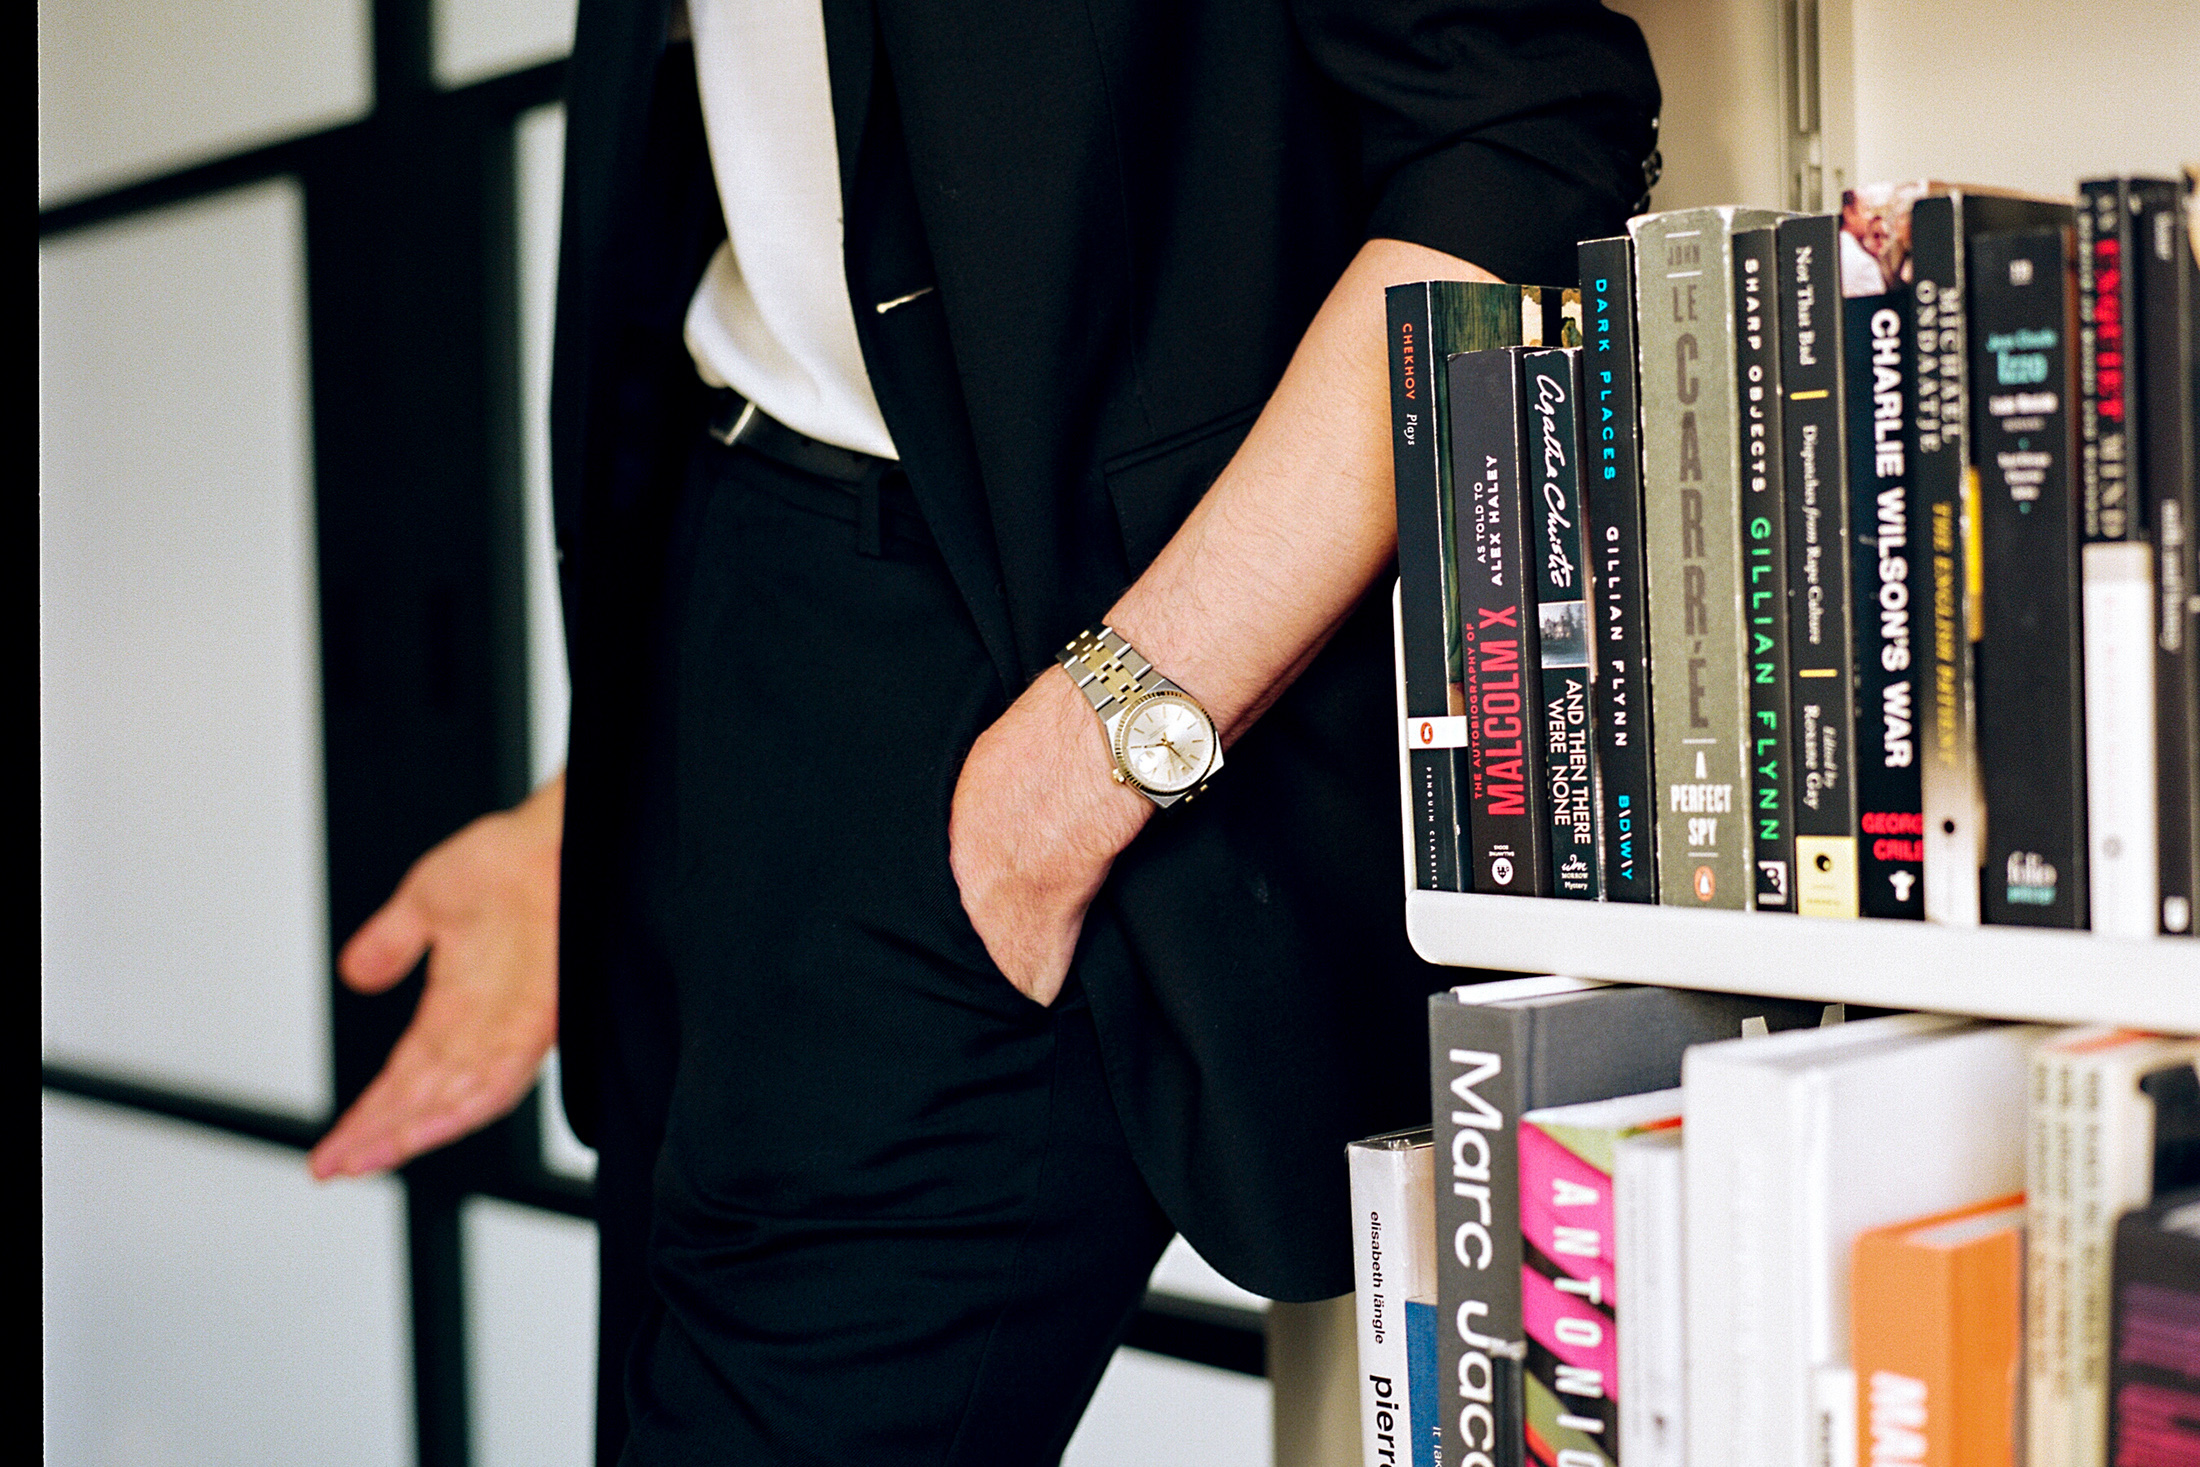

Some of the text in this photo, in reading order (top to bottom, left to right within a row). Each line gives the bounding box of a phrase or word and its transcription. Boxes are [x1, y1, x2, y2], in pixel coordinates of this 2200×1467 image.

[1400, 322, 1416, 399] CHEKHOV
[1672, 284, 1697, 323] LE
[1745, 258, 1767, 492] SHARP OBJECTS
[1796, 246, 1816, 365] Not That Bad
[1916, 280, 1942, 453] ONDAATJE
[1939, 287, 1961, 444] MICHAEL
[1404, 413, 1418, 446] Plays
[1596, 278, 1616, 480] DARK PLACES
[1474, 481, 1486, 563] AS TOLD TO
[1486, 456, 1503, 586] ALEX HALEY
[1534, 374, 1574, 588] Agatha Christie
[1871, 309, 1913, 768] CHARLIE WILSON'S WAR
[1606, 526, 1627, 746] GILLIAN FLYNN
[1751, 517, 1779, 839] GILLIAN FLYNN
[1466, 623, 1482, 799] THE AUTOBIOGRAPHY OF
[1478, 605, 1526, 816] MALCOLM X
[1548, 699, 1571, 826] WERE NONE
[1566, 679, 1591, 844] AND THEN THERE
[1694, 751, 1707, 779] A
[1670, 784, 1732, 812] PERFECT
[1688, 818, 1717, 846] SPY
[1449, 1049, 1504, 1271] Marc
[1370, 1211, 1386, 1344] elisabeth längle
[1369, 1374, 1399, 1467] pierr
